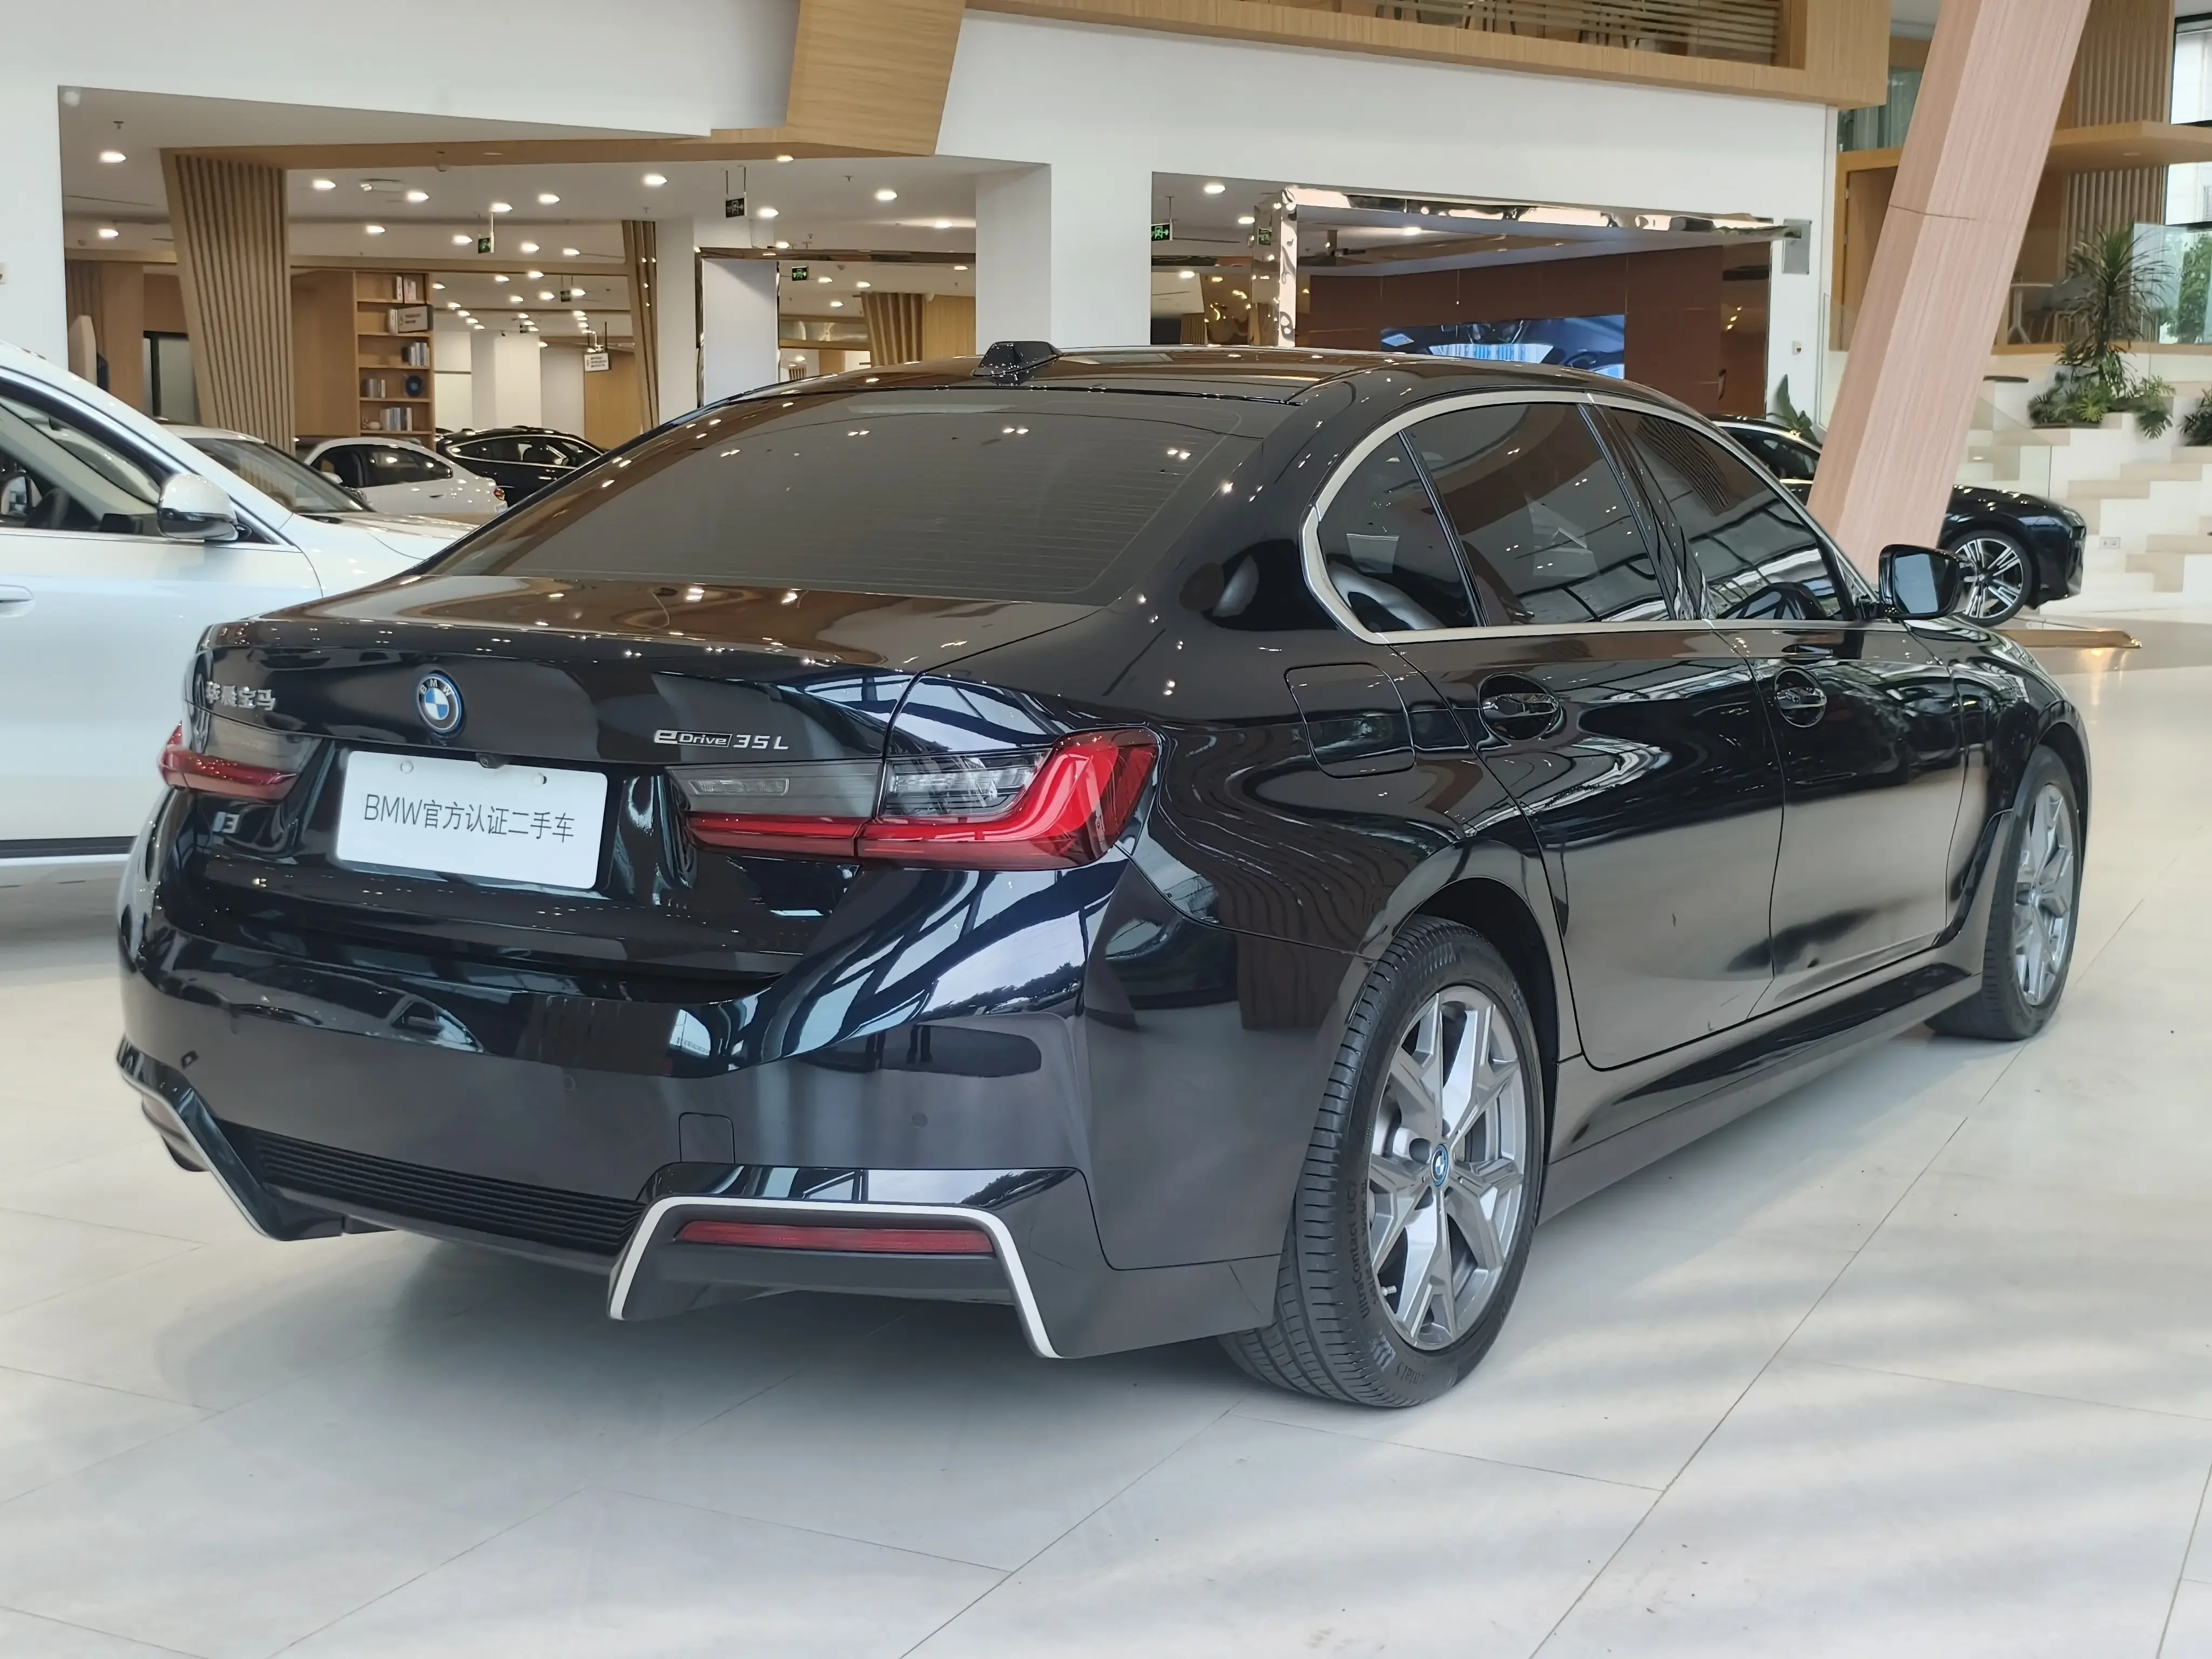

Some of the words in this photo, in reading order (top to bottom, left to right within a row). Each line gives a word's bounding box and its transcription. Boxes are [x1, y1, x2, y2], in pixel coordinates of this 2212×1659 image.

[420, 678, 452, 697] BMW
[364, 793, 575, 843] BMW官方认证二手车
[1348, 1221, 1370, 1320] UltraContact
